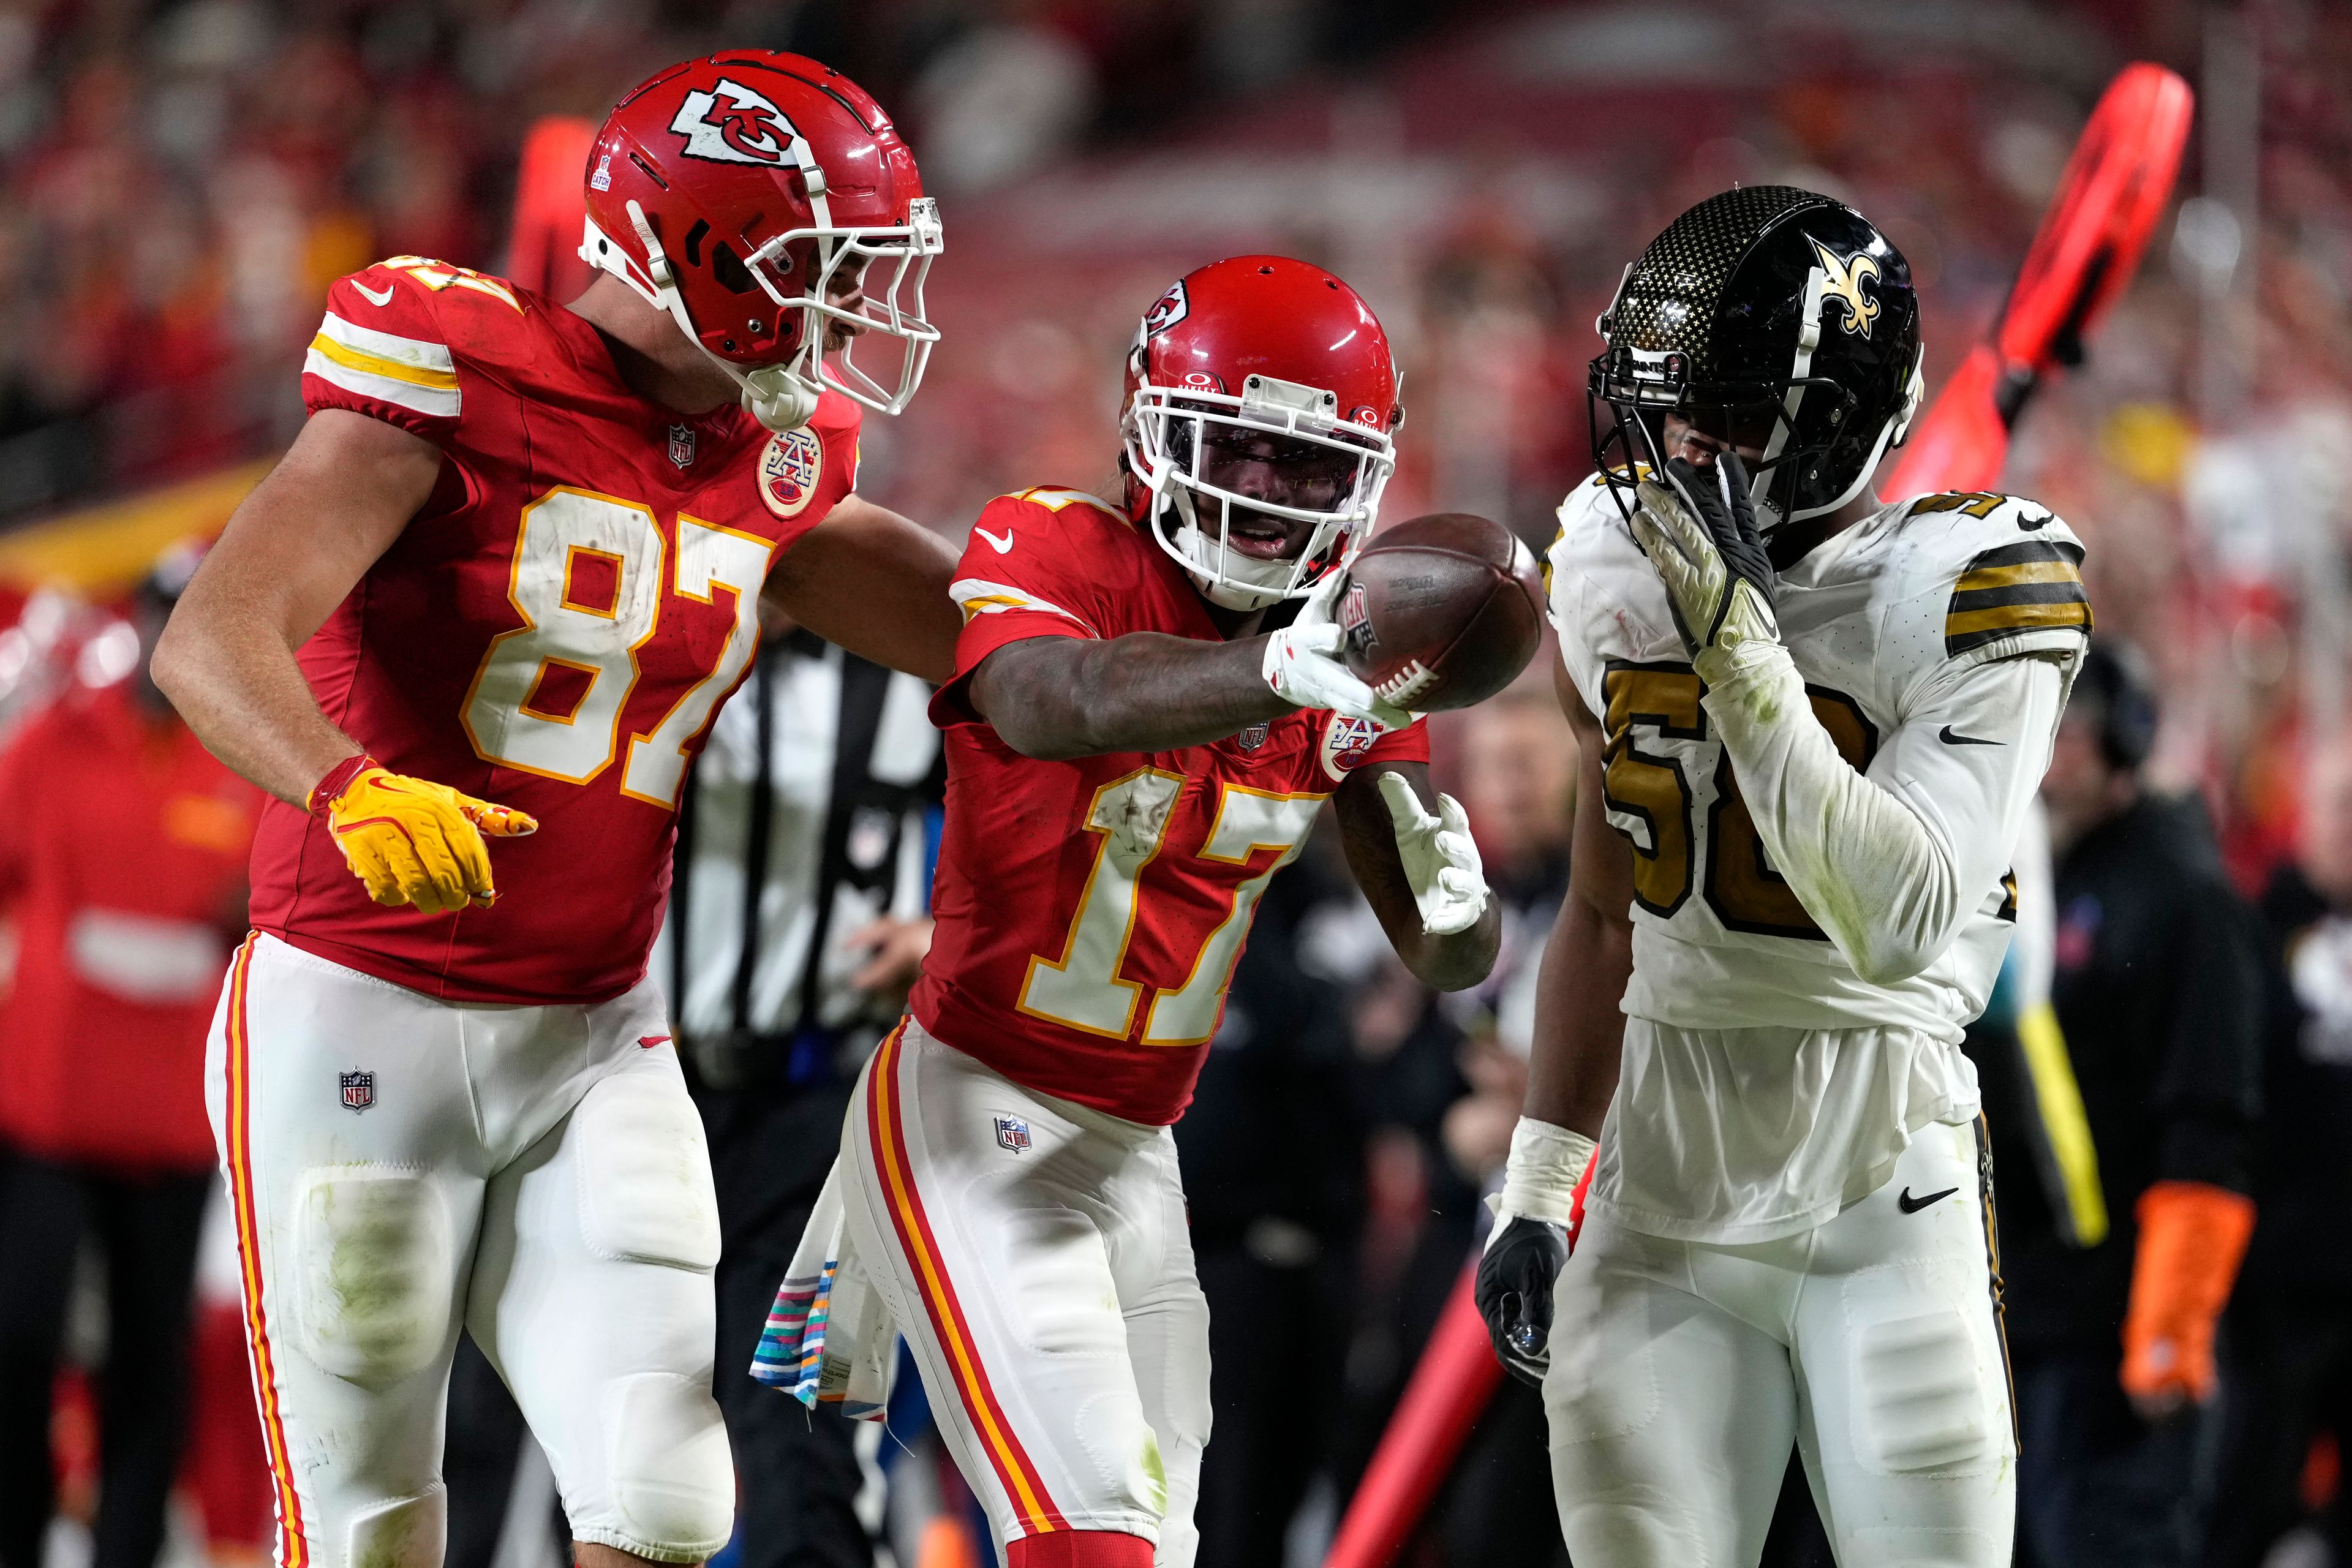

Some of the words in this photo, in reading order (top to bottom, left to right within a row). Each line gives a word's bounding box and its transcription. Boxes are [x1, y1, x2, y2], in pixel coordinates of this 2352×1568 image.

[699, 93, 794, 162] KC
[592, 175, 610, 187] CATCH
[635, 222, 654, 238] 87
[673, 442, 690, 461] NFL
[1343, 591, 1366, 629] NFL
[458, 484, 778, 812] 87
[1244, 728, 1264, 745] NFL
[1015, 764, 1334, 1046] 17
[345, 1087, 370, 1105] NFL
[1004, 1131, 1028, 1146] NFL
